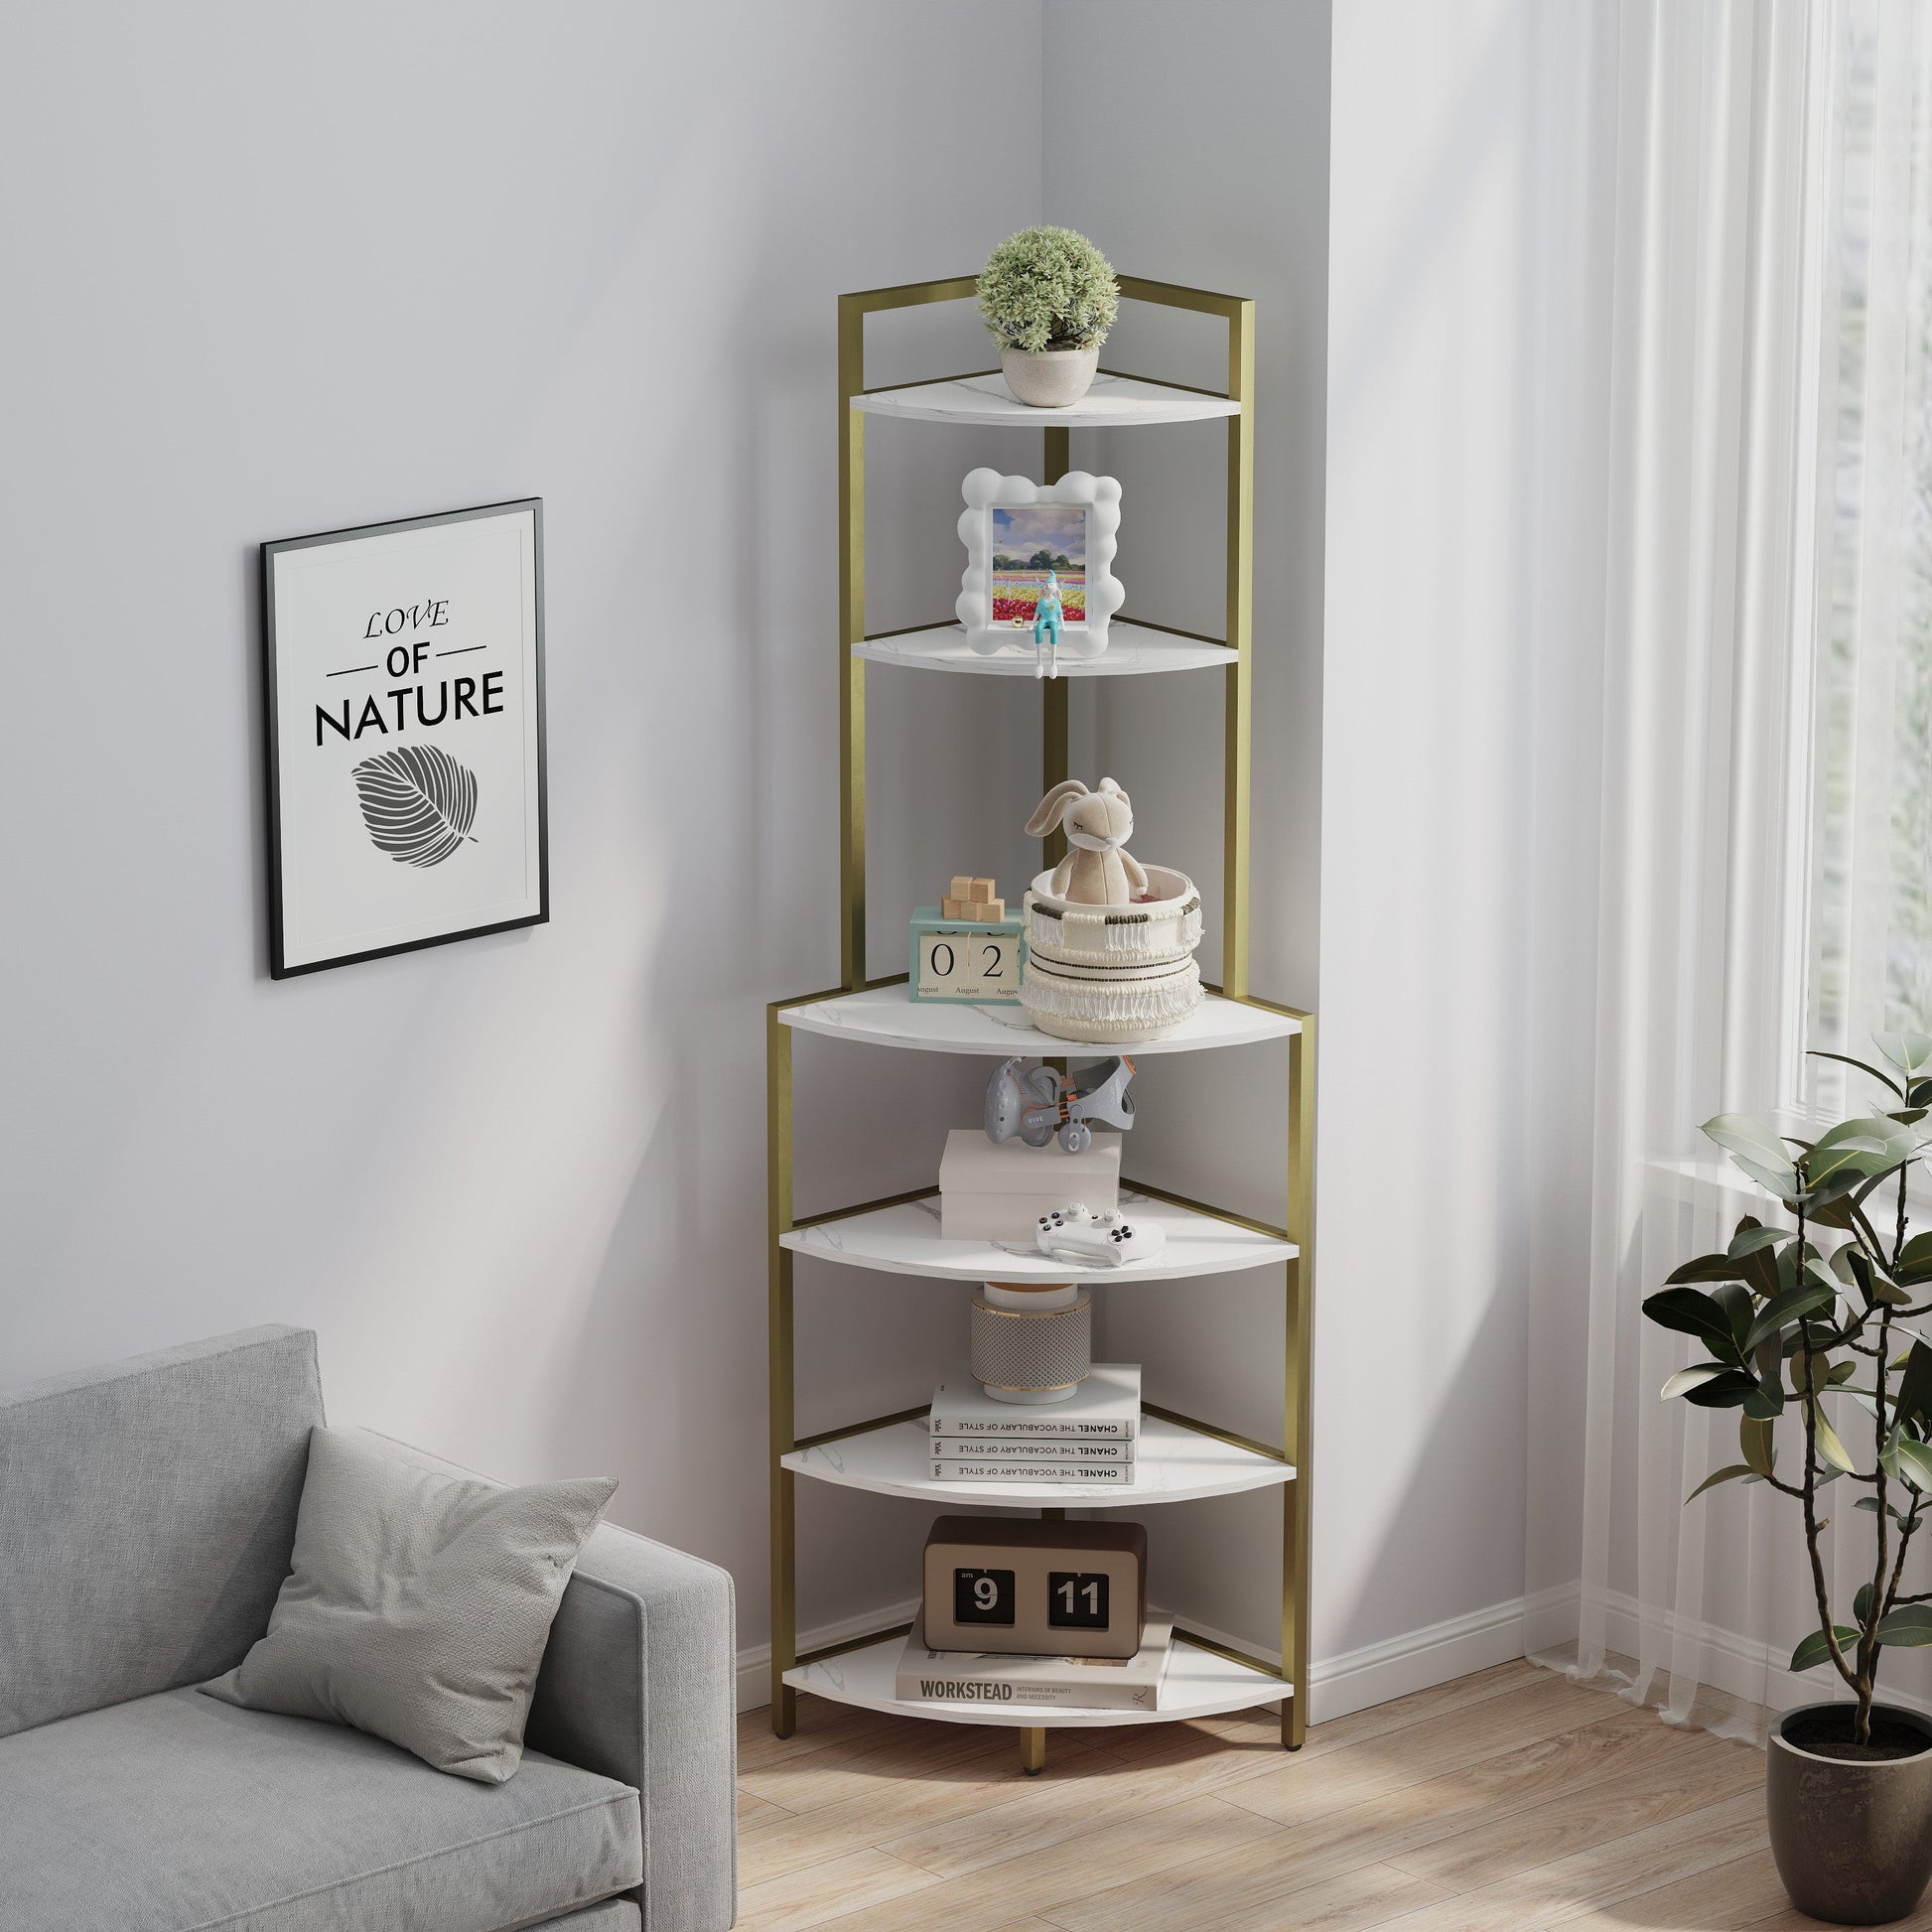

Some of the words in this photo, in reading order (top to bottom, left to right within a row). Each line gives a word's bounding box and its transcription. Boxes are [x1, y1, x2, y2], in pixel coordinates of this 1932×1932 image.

[363, 599, 450, 639] LOVE
[386, 640, 431, 678] OF
[316, 670, 504, 747] NATURE
[1000, 1423, 1058, 1432] VOCABULARY
[1000, 1446, 1058, 1454] VOCABULARY
[1000, 1468, 1058, 1477] VOCABULARY
[974, 1578, 999, 1610] 9
[1057, 1581, 1098, 1615] 11
[919, 1680, 1013, 1701] WORKSTEAD
